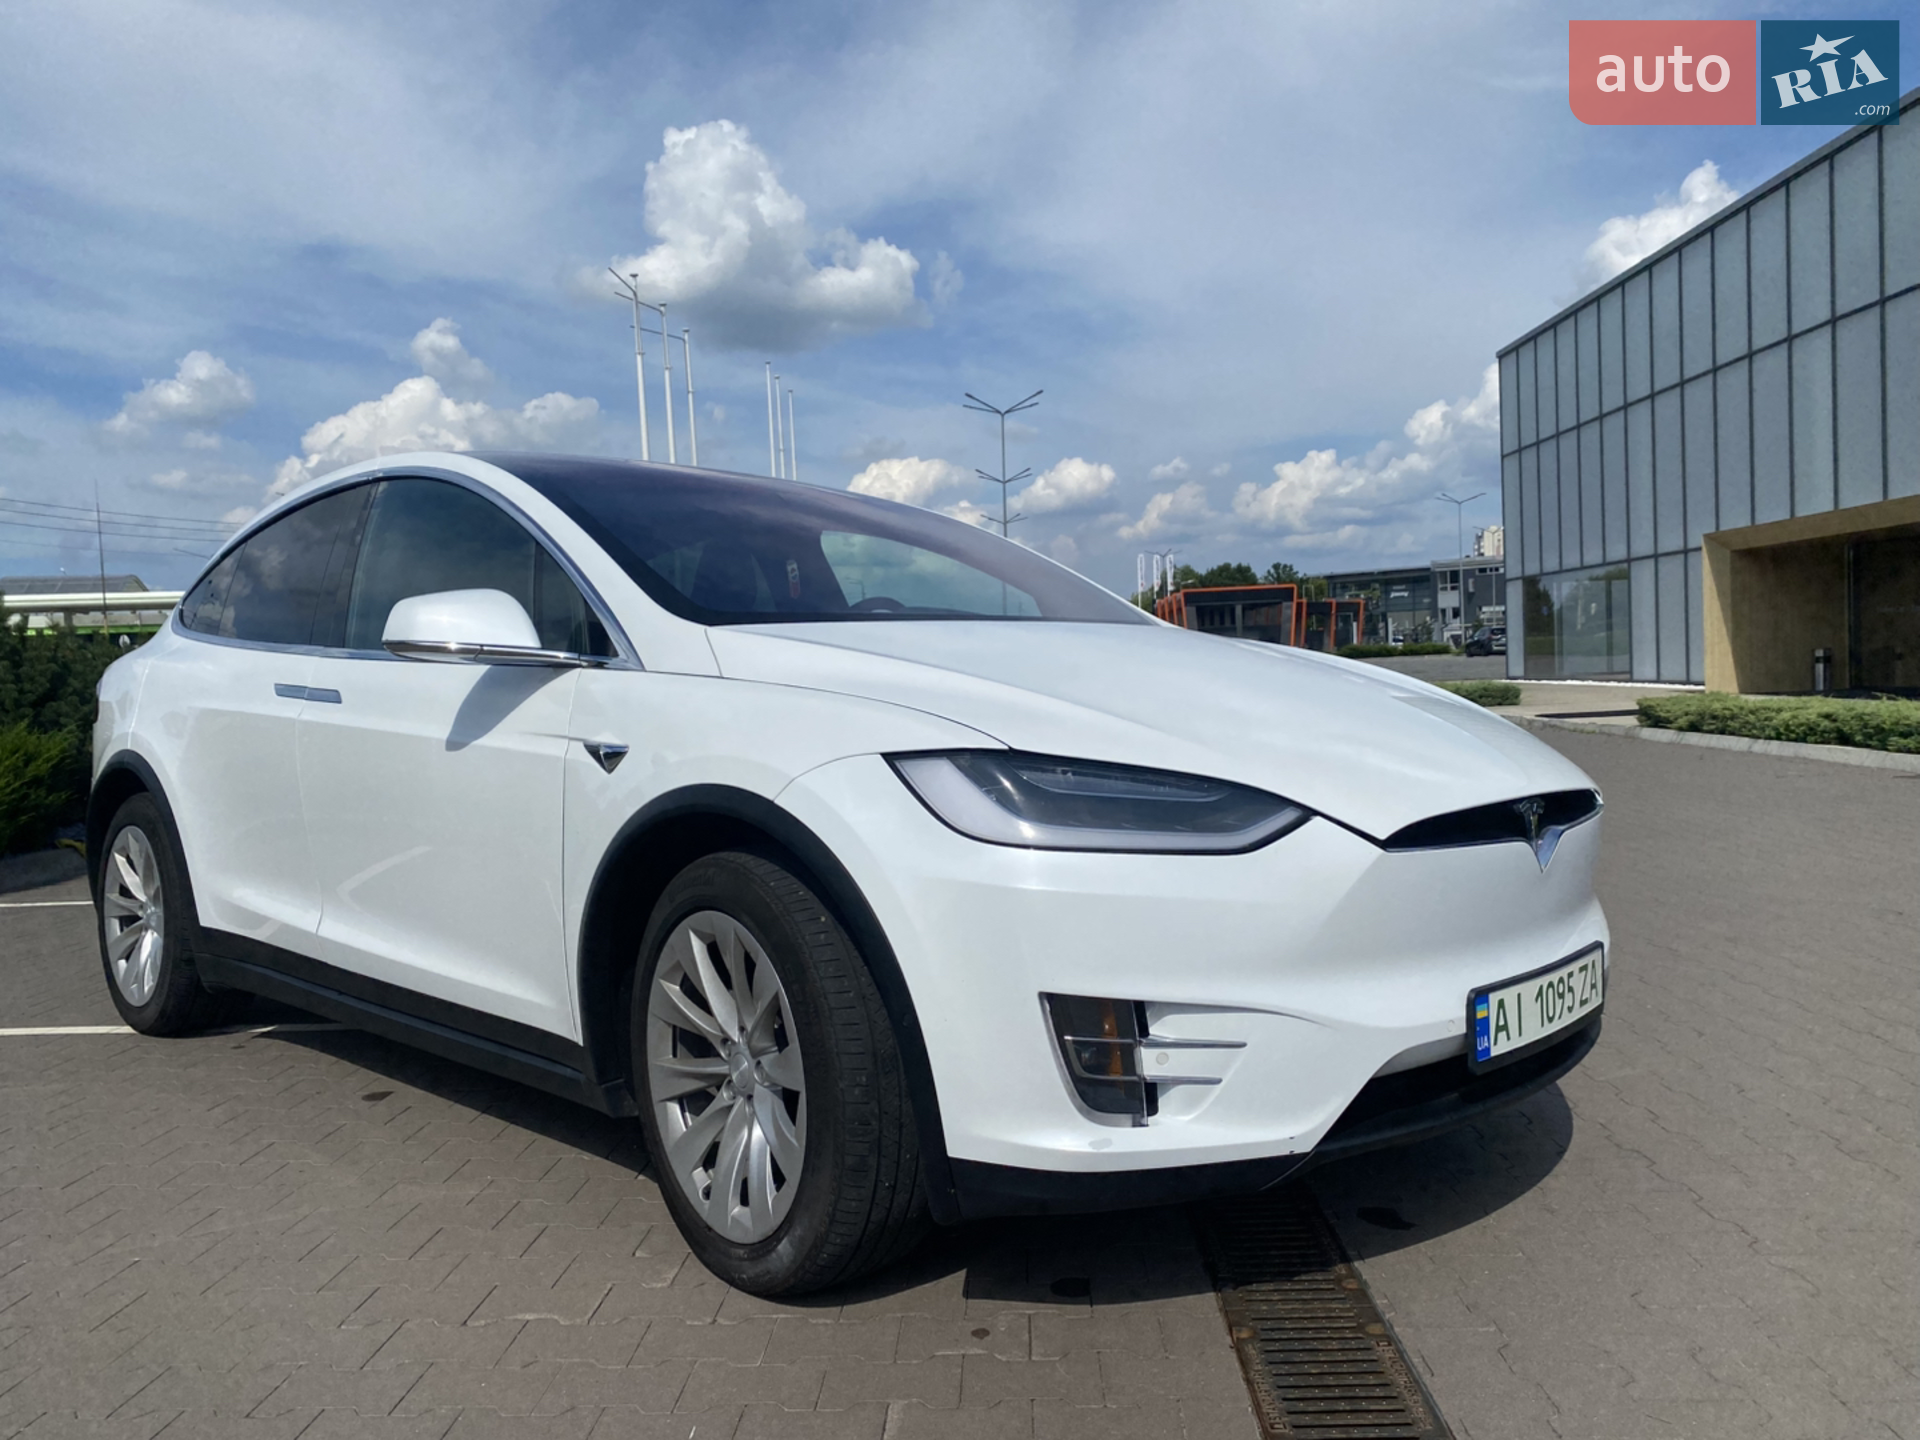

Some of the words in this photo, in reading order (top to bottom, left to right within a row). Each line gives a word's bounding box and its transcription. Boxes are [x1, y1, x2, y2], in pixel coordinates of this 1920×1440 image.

[1493, 992, 1522, 1046] AI
[1535, 971, 1575, 1028] 1095
[1578, 959, 1598, 1008] ZA
[1477, 1035, 1489, 1050] UA
